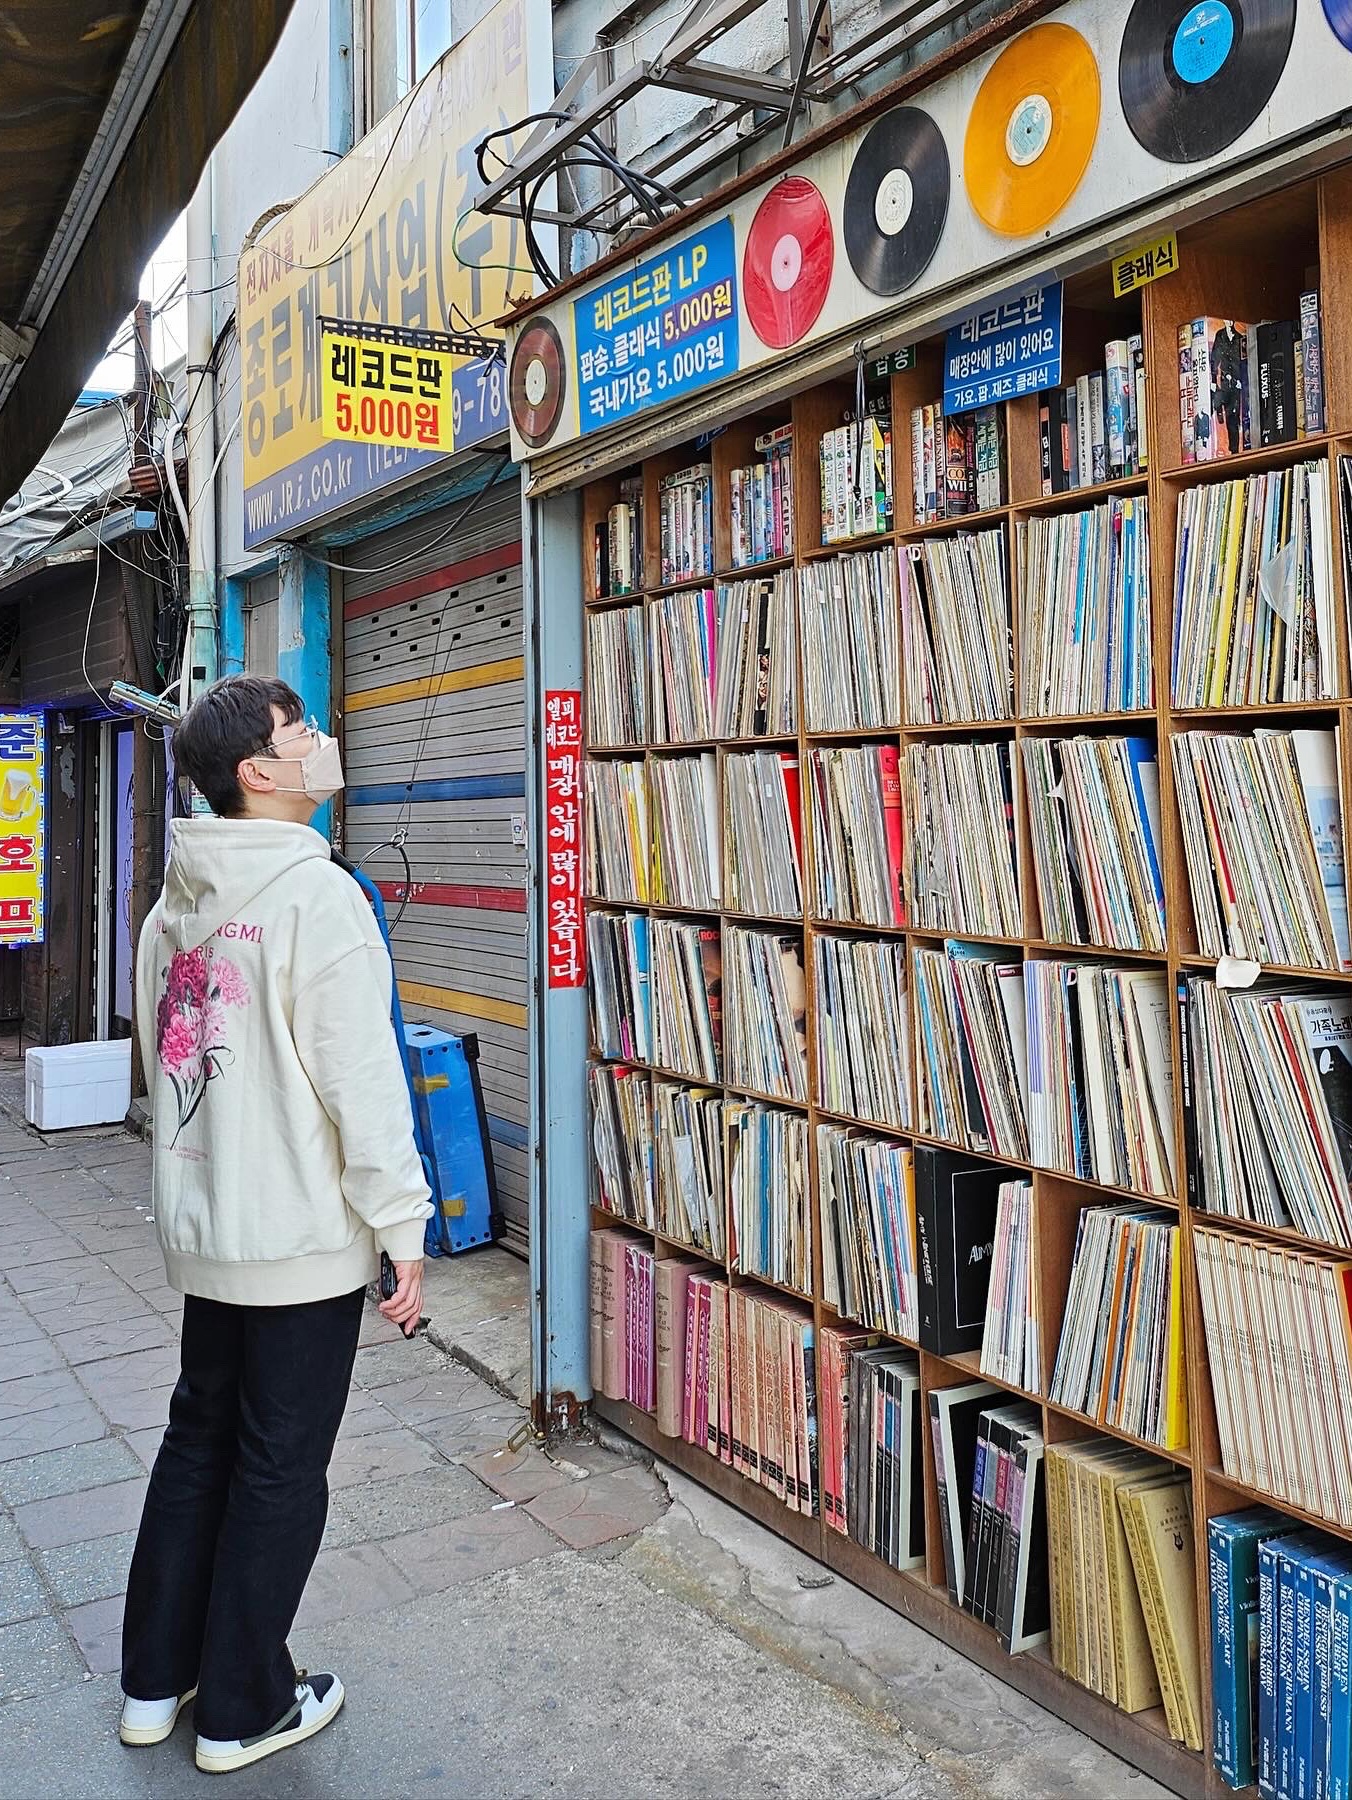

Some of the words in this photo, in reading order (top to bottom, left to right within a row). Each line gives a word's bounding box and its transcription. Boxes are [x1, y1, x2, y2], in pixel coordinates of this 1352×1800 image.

[594, 266, 672, 332] 레코드판
[678, 244, 708, 290] LP
[1116, 238, 1175, 292] 클래식
[663, 281, 733, 342] 5,000원
[331, 343, 443, 398] 레코드판
[590, 366, 653, 417] 국내가요
[656, 332, 725, 390] 5.000원
[949, 343, 992, 379] 매장안에
[994, 337, 1017, 371] 많이
[1020, 327, 1054, 362] 있어요
[954, 366, 1049, 409] 가요.팝.재즈.클래식
[1261, 363, 1269, 399] FLUXUS
[336, 393, 440, 445] 5,000원
[546, 696, 575, 722] 엘피
[546, 723, 579, 750] 레코드
[548, 755, 578, 797] 매장
[550, 801, 577, 844] 안에
[550, 849, 577, 892] 많이
[550, 896, 581, 982] 있습니다
[1221, 1559, 1231, 1668] HAYDN/MOZART
[1259, 1572, 1268, 1689] RIMSKY-KORSAKOV
[1265, 1576, 1273, 1696] MUSSORGSKY/GRIEG
[1279, 1582, 1287, 1679] MENDELSSOHN
[1296, 1591, 1304, 1683] CHOPIN/LISZT
[1301, 1596, 1311, 1693] MENDELSSOHN
[1314, 1600, 1322, 1667] CHAUSSON
[1333, 1609, 1342, 1681] SCHUBERT
[1285, 1586, 1294, 1734] SCHUBERT/SCHUMANN
[1319, 1604, 1329, 1721] RESPIGHI/DEBUSSY
[1340, 1613, 1349, 1696] BEETHOVEN
